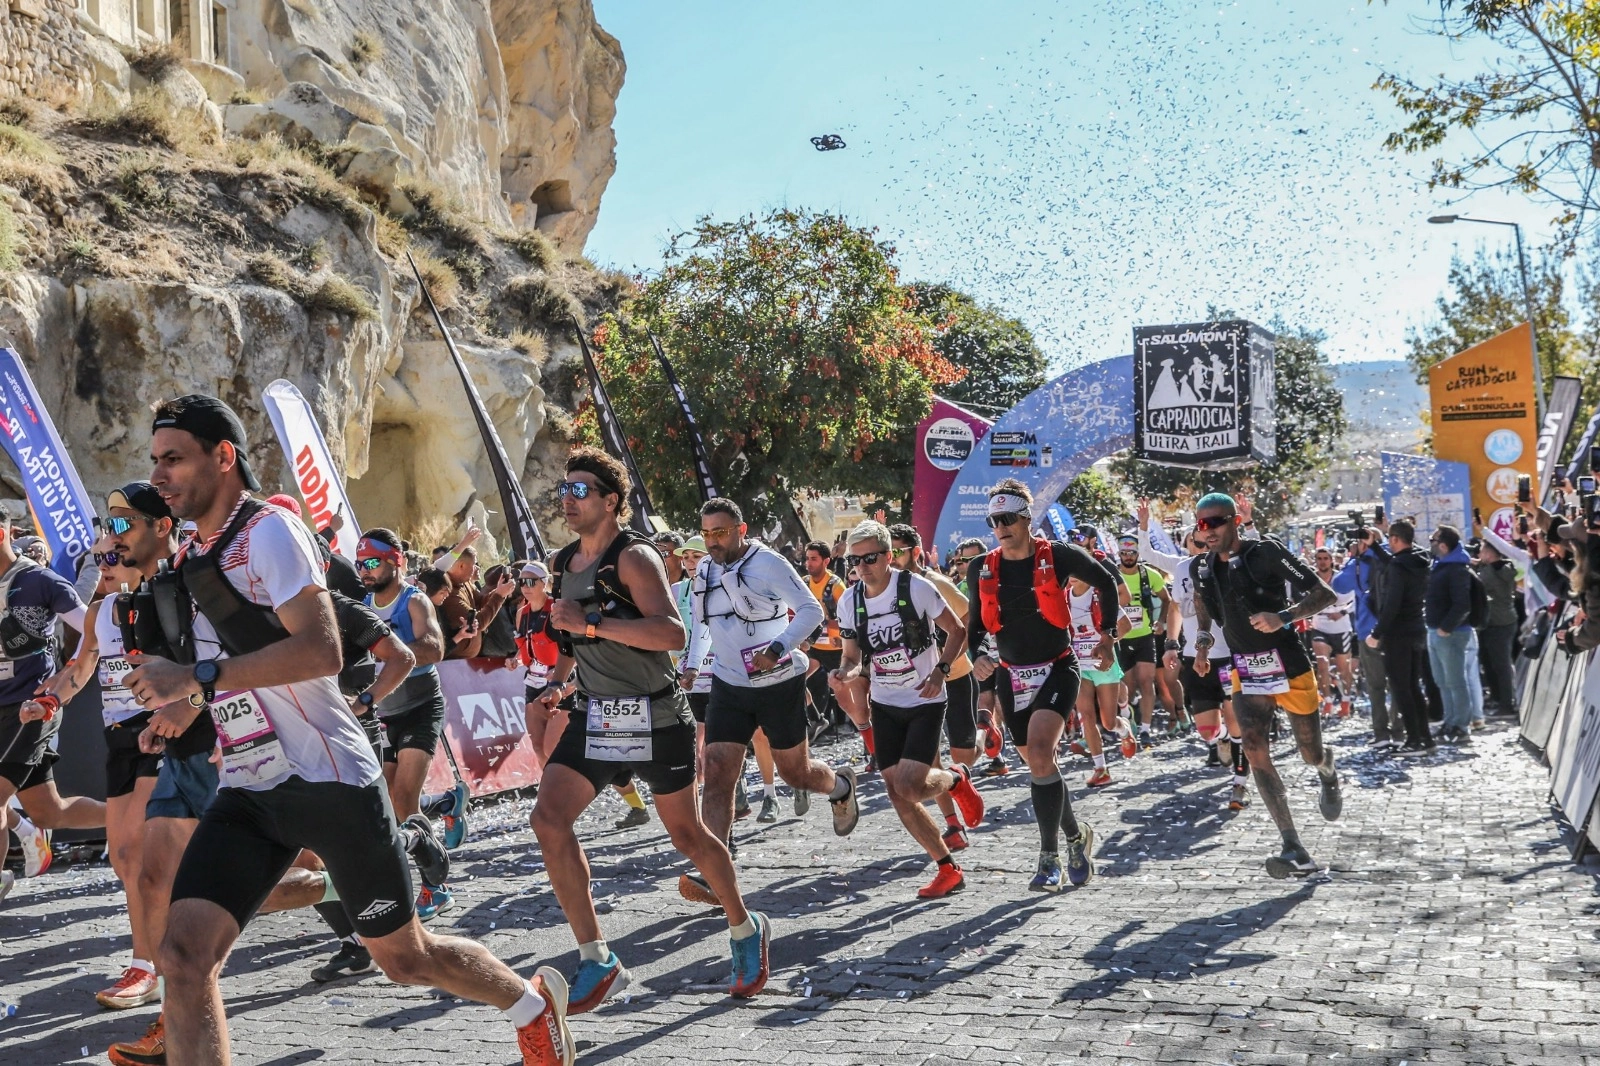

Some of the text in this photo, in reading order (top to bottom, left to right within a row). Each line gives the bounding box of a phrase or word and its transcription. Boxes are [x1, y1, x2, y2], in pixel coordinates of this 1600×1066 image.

[1150, 331, 1227, 345] SALOMON
[1458, 364, 1486, 377] RUN
[1446, 371, 1517, 391] CAPPADOCIA
[1149, 406, 1233, 430] CAPPADOCIA
[1149, 432, 1232, 451] ULTRA TRAIL
[877, 653, 902, 665] 2032
[1247, 656, 1274, 666] 2965
[1020, 668, 1046, 678] 2054
[603, 704, 640, 716] 6552
[378, 904, 398, 916] TRAIL
[544, 1010, 563, 1060] TERREX
